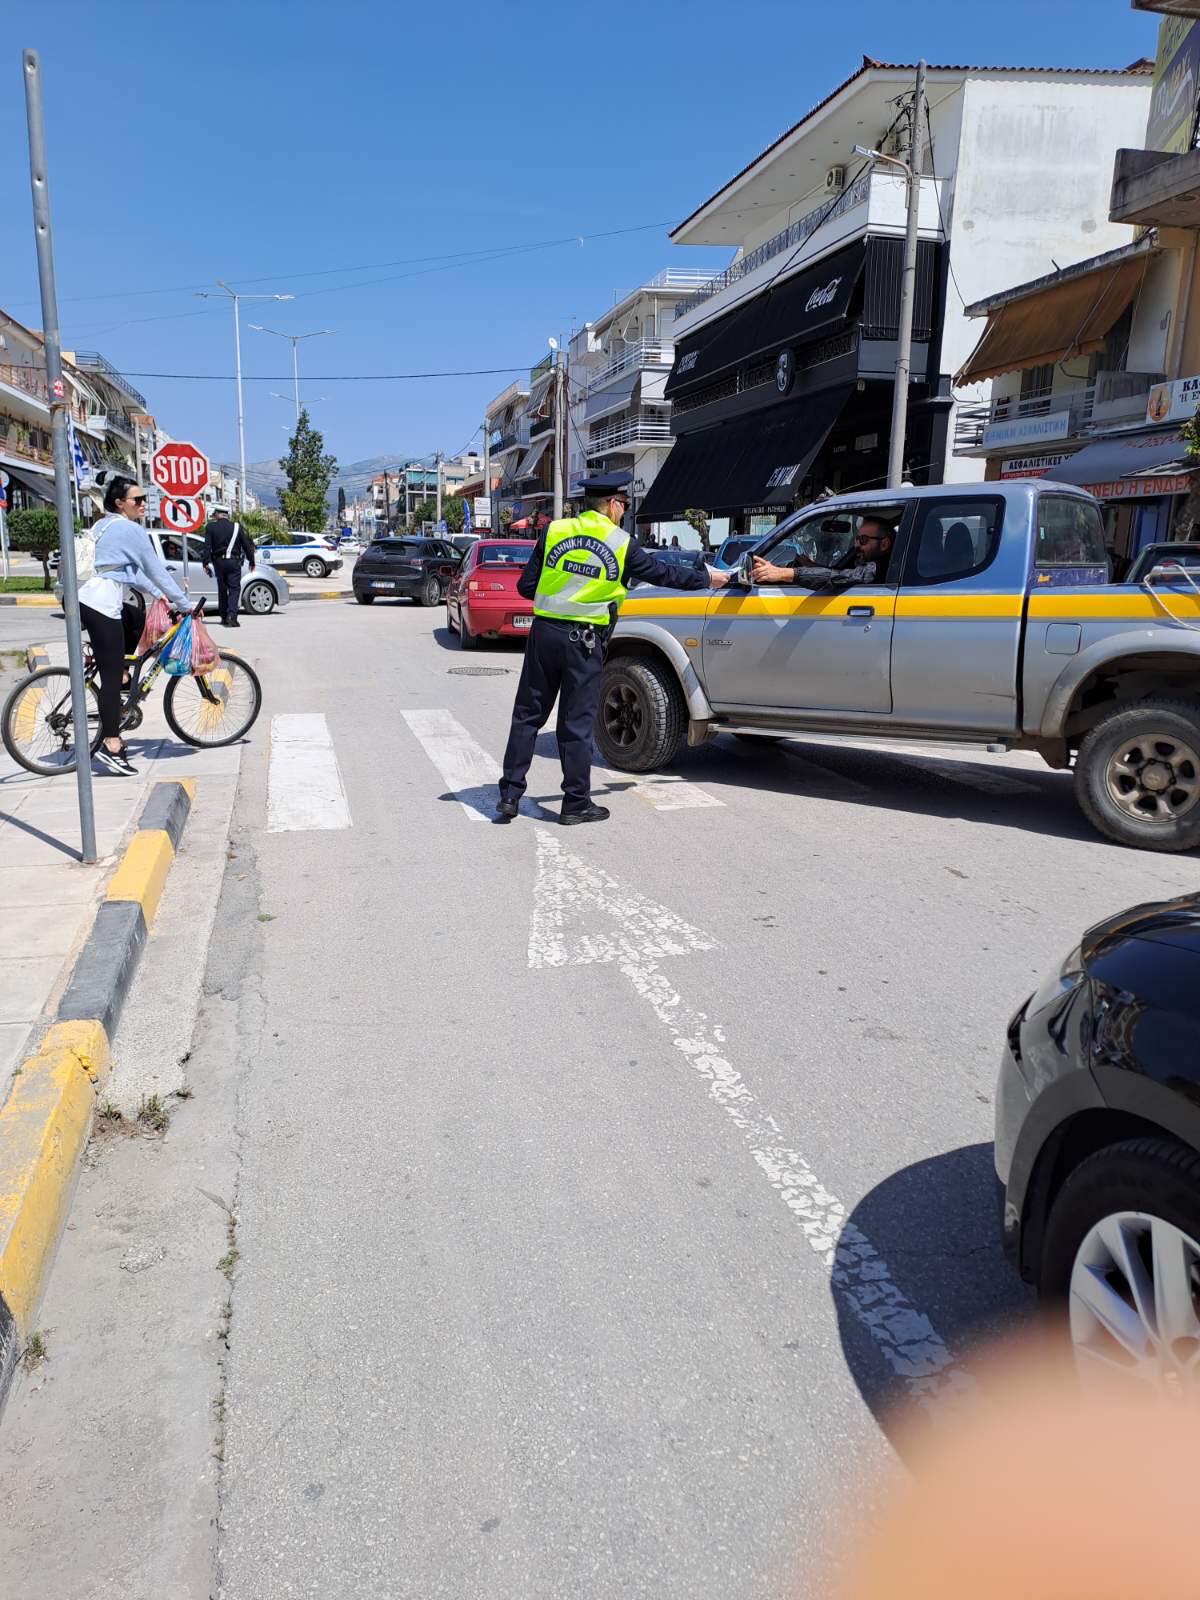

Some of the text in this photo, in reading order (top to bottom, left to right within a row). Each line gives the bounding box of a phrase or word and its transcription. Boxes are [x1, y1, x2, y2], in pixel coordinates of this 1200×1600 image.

[1183, 378, 1200, 392] ΚΑ
[155, 455, 205, 485] STOP
[1009, 456, 1062, 470] ΑΣΦΑΛΙΣΤΙΚΕΣ
[1128, 480, 1138, 496] Η
[1143, 474, 1192, 494] ΕΝΔΕΚ
[547, 537, 616, 579] ΕΛΛΗΝΙΚΗ ΑΣΤΥΝΟΜΙΑ
[567, 562, 596, 576] POLICE
